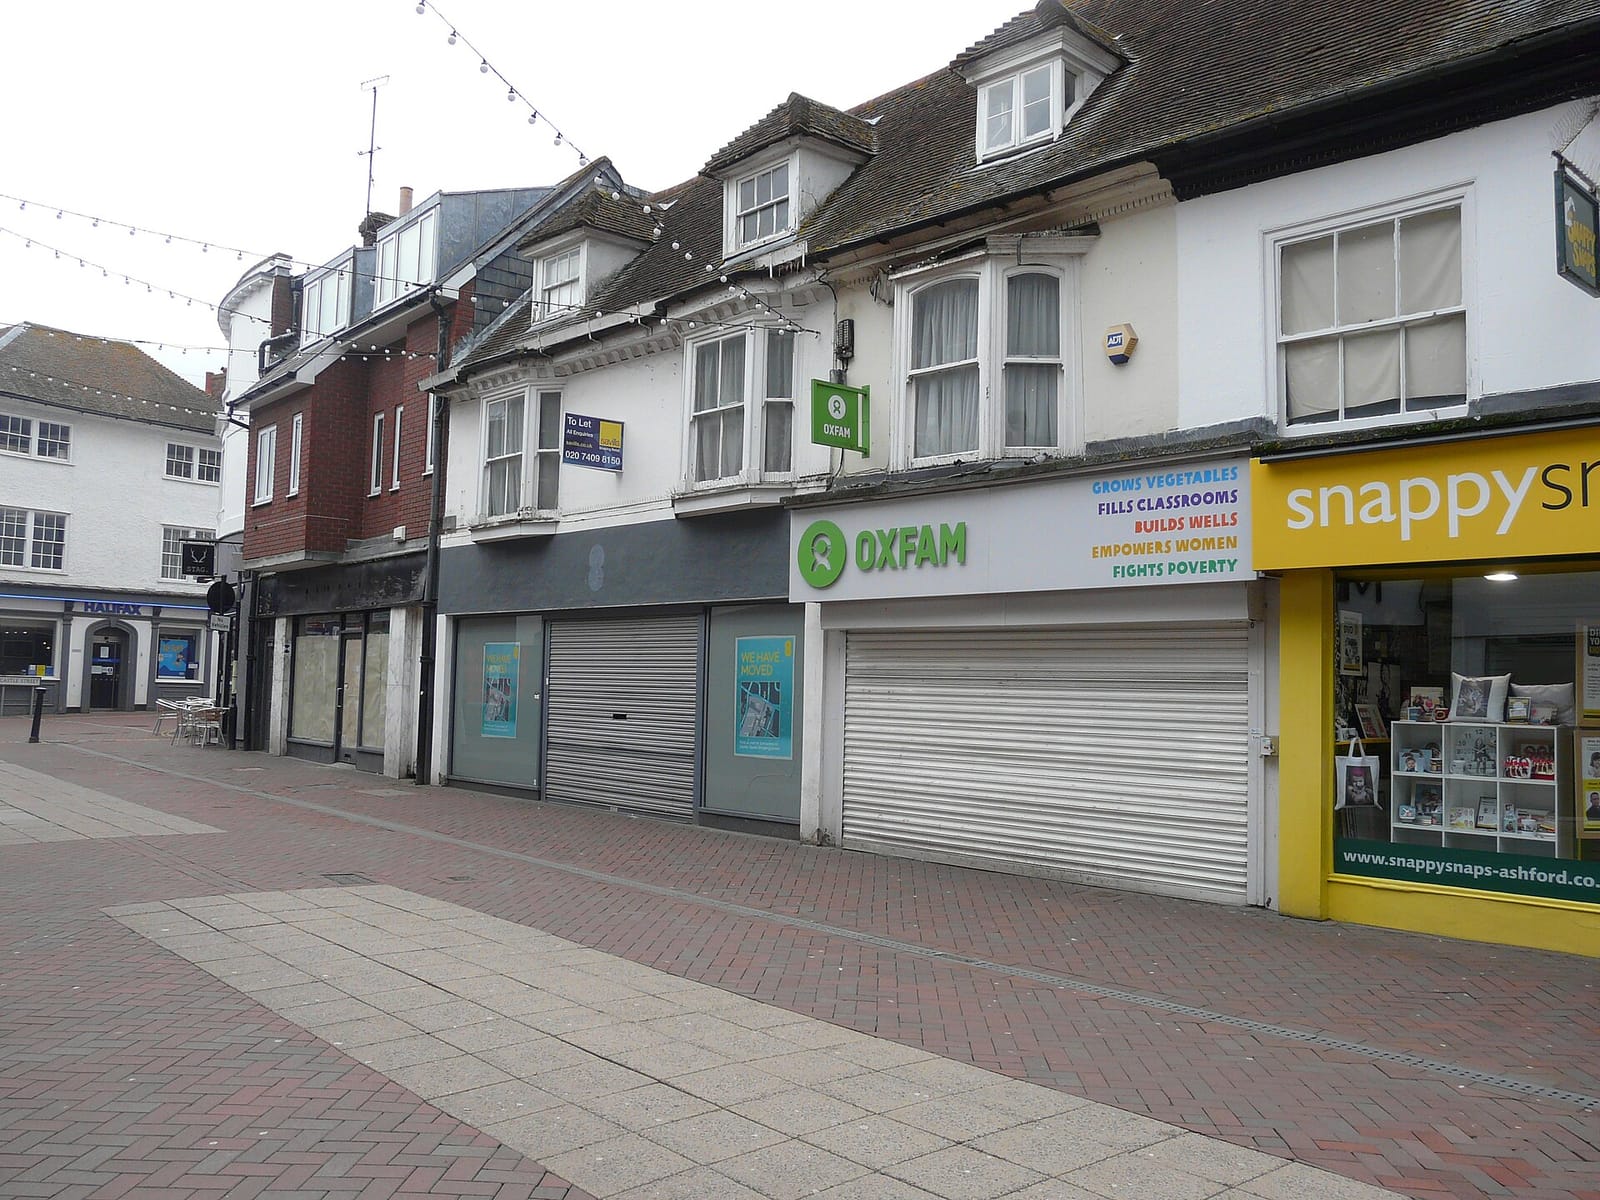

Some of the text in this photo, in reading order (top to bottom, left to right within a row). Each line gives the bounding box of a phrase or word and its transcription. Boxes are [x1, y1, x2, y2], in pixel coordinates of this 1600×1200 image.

[1108, 336, 1122, 345] ADT
[567, 416, 592, 428] To Let
[823, 423, 851, 439] OXFAM
[565, 450, 621, 465] 020 7409 8150
[1092, 466, 1239, 494] GROWS VEGETABLES
[1098, 489, 1239, 515] FILLS CLASSROOMS
[1134, 512, 1238, 534] BUILDS WELLS
[855, 521, 967, 571] OXFAM
[1092, 535, 1238, 559] EMPOWERS WOMEN
[1113, 558, 1238, 578] FIGHTS POVERTY
[84, 601, 142, 616] HALIFAX
[741, 651, 780, 663] WE HAVE
[741, 664, 773, 676] MOVED
